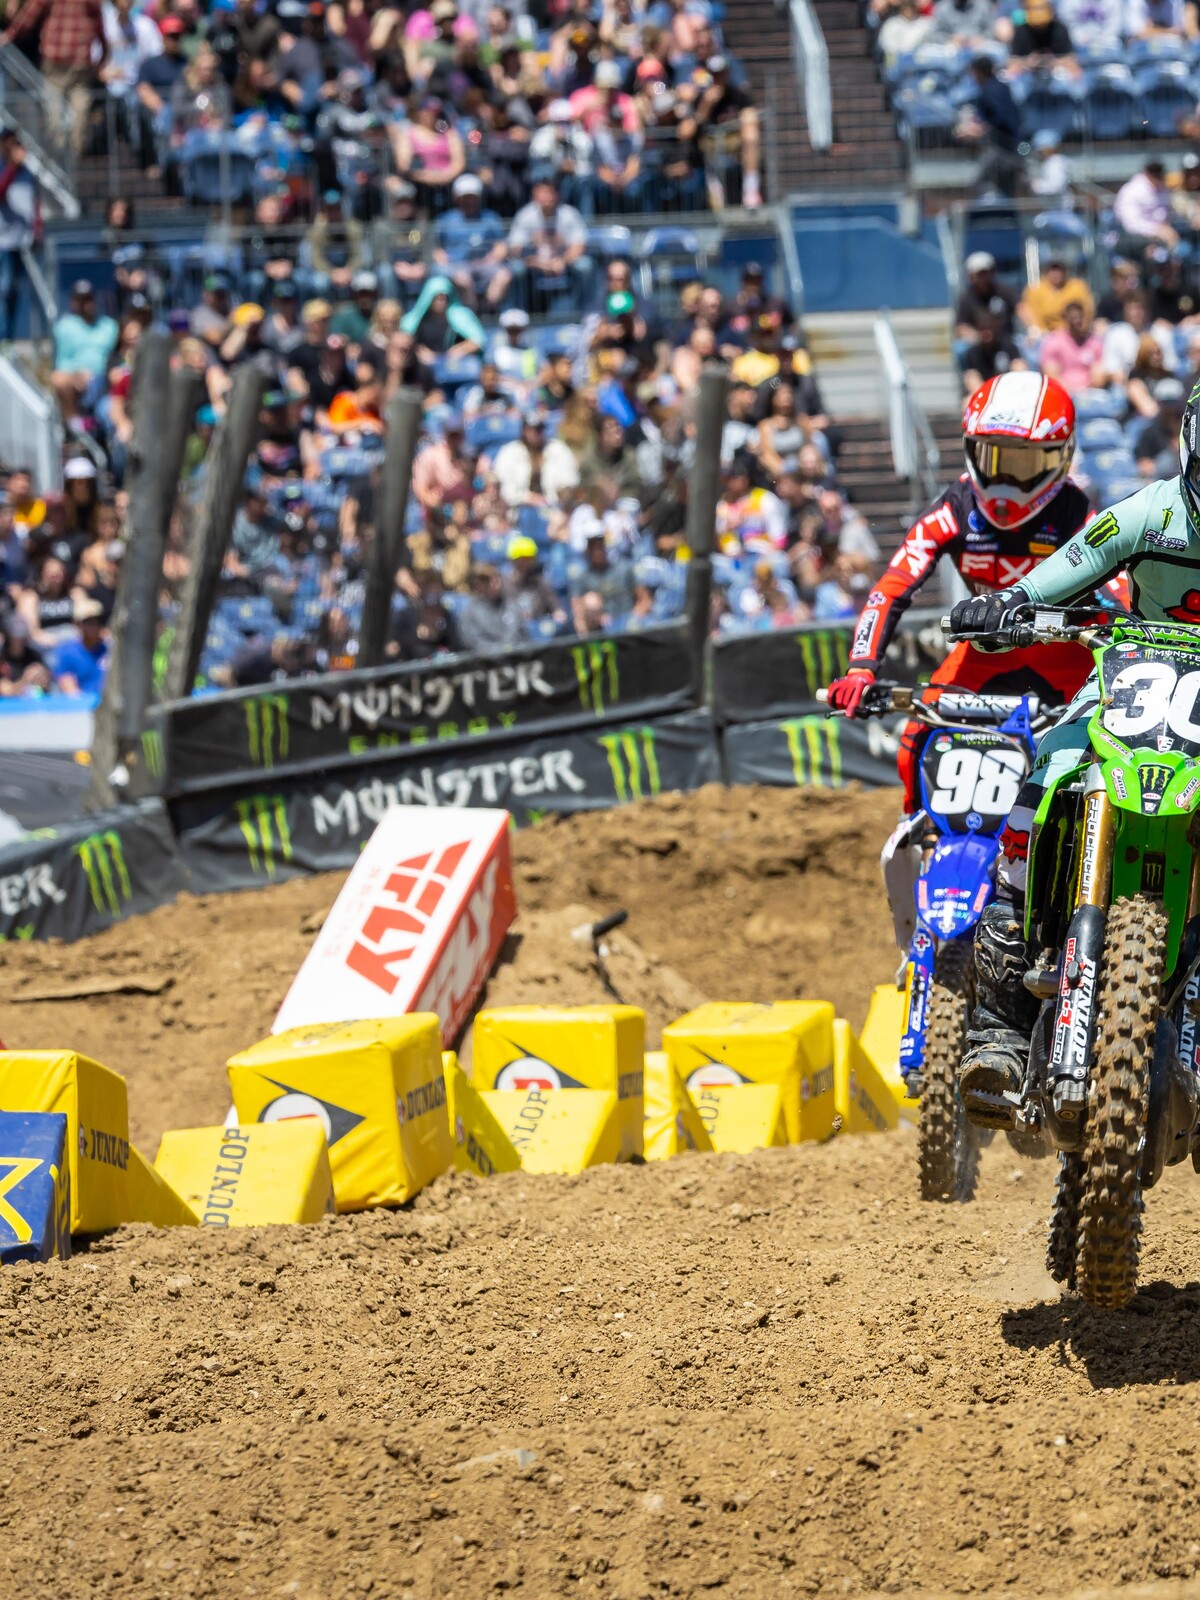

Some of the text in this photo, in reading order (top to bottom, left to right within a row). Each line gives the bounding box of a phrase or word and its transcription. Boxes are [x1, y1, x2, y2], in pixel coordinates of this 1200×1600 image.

[890, 505, 959, 577] FXR
[310, 660, 554, 731] MONSTER
[348, 711, 517, 756] ENERGY
[311, 750, 586, 835] MONSTER
[930, 748, 1026, 814] 98
[1073, 957, 1097, 1065] DUNLOP
[90, 1128, 130, 1171] DUNLOP
[203, 1128, 250, 1228] DUNLOP
